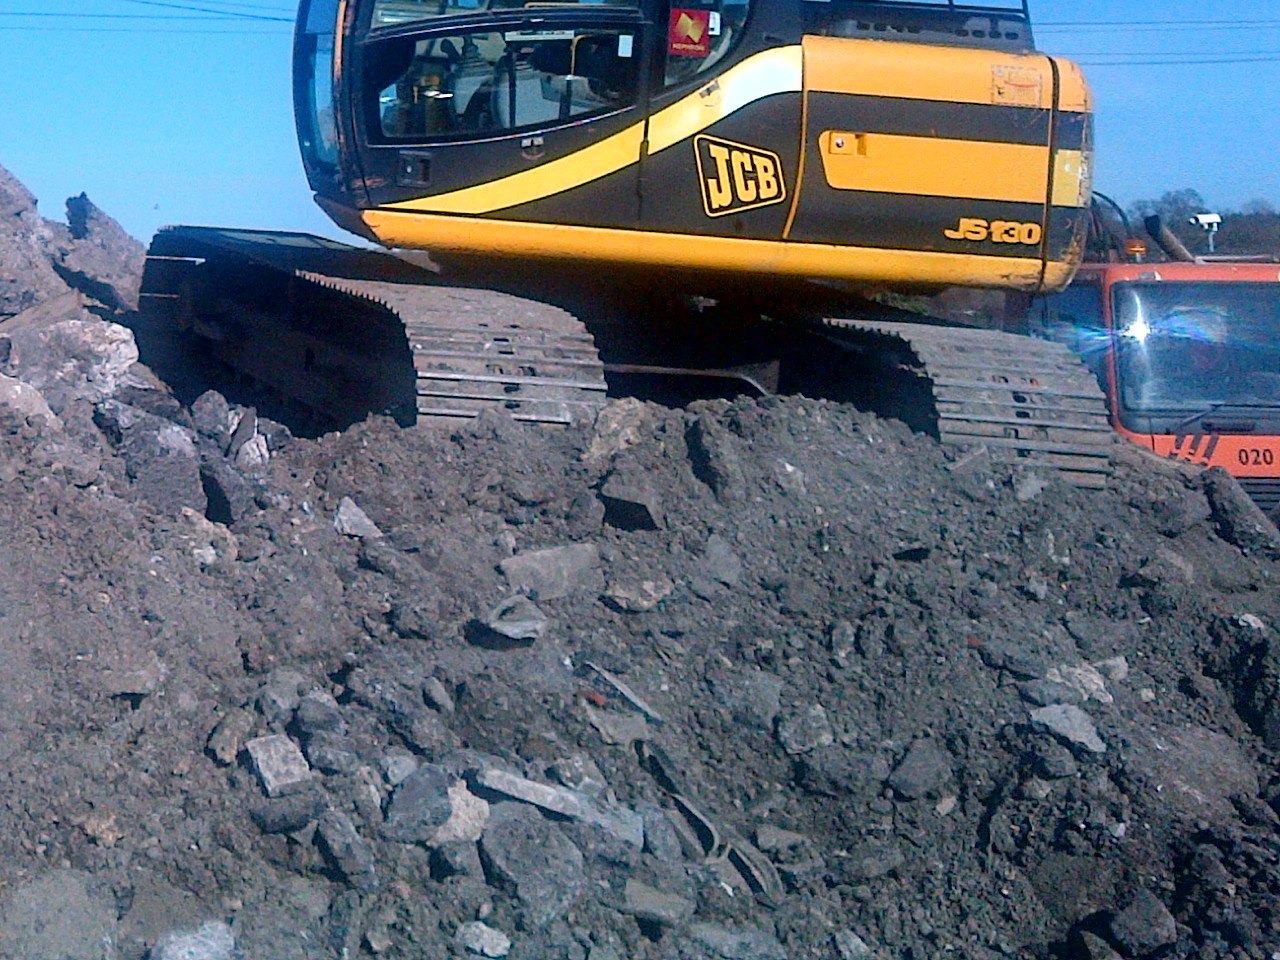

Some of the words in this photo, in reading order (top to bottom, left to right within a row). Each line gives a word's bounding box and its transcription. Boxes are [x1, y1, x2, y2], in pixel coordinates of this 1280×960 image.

[707, 144, 778, 209] JCB
[943, 218, 1041, 245] JS130
[1238, 448, 1274, 466] 020
